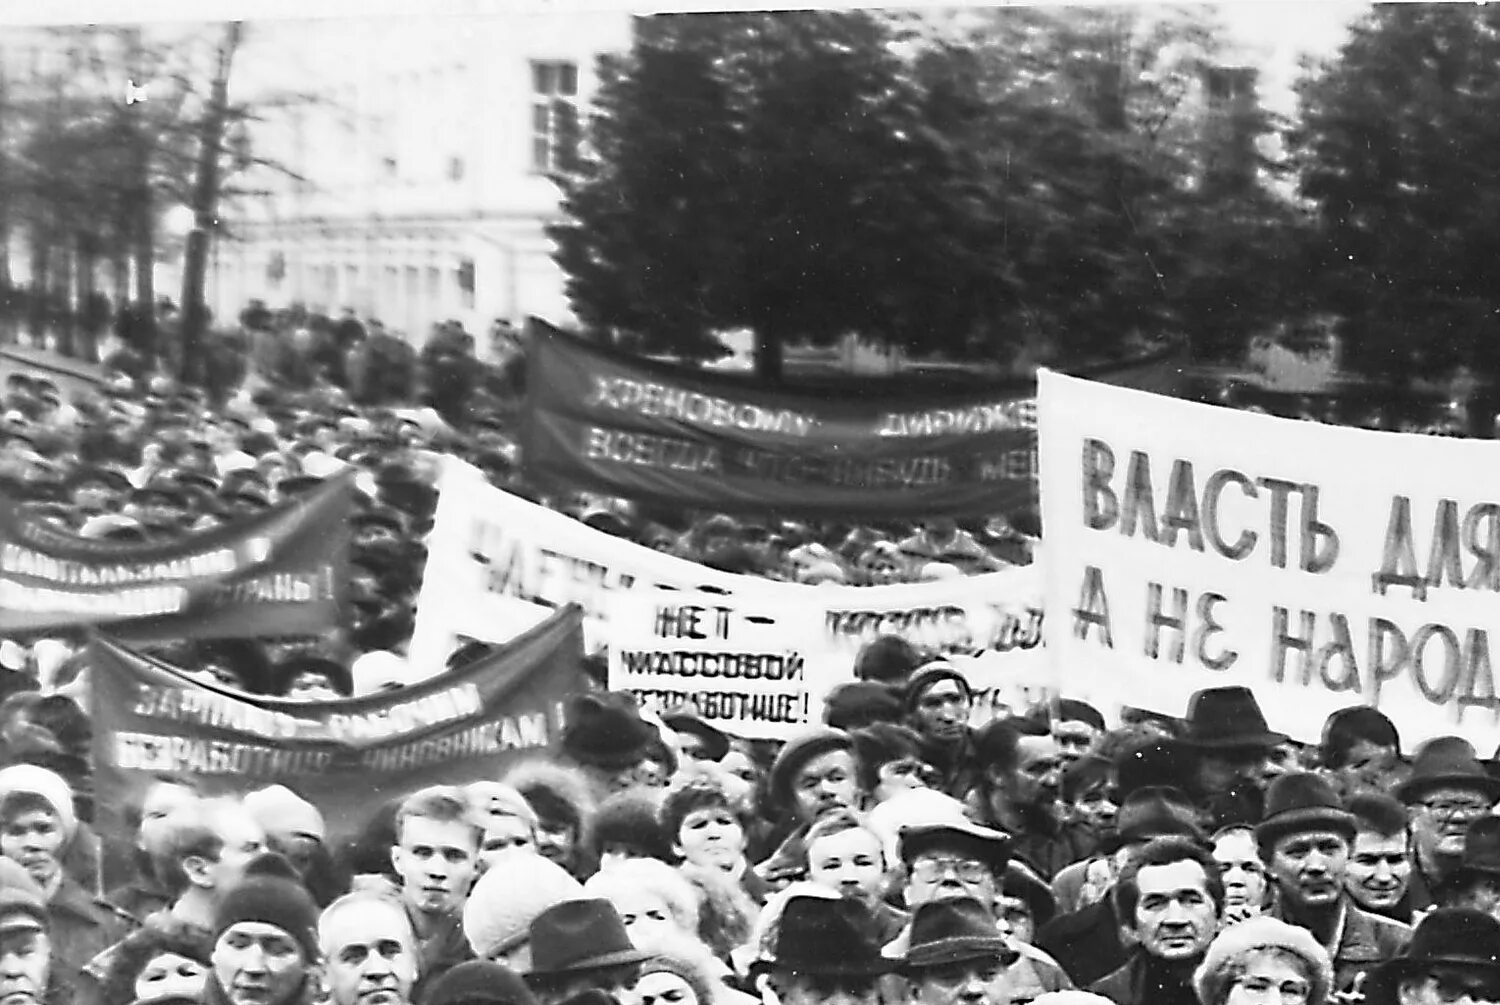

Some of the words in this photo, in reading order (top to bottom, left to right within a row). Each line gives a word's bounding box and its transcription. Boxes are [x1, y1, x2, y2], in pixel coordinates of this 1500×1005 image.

[582, 426, 722, 474] ВСЕГДА
[1082, 438, 1340, 574] ВЛАСТЬ
[654, 605, 734, 640] НЕТ
[1072, 566, 1113, 649] А
[1144, 582, 1238, 671] НЕ
[621, 650, 805, 681] МАССОВОЙ
